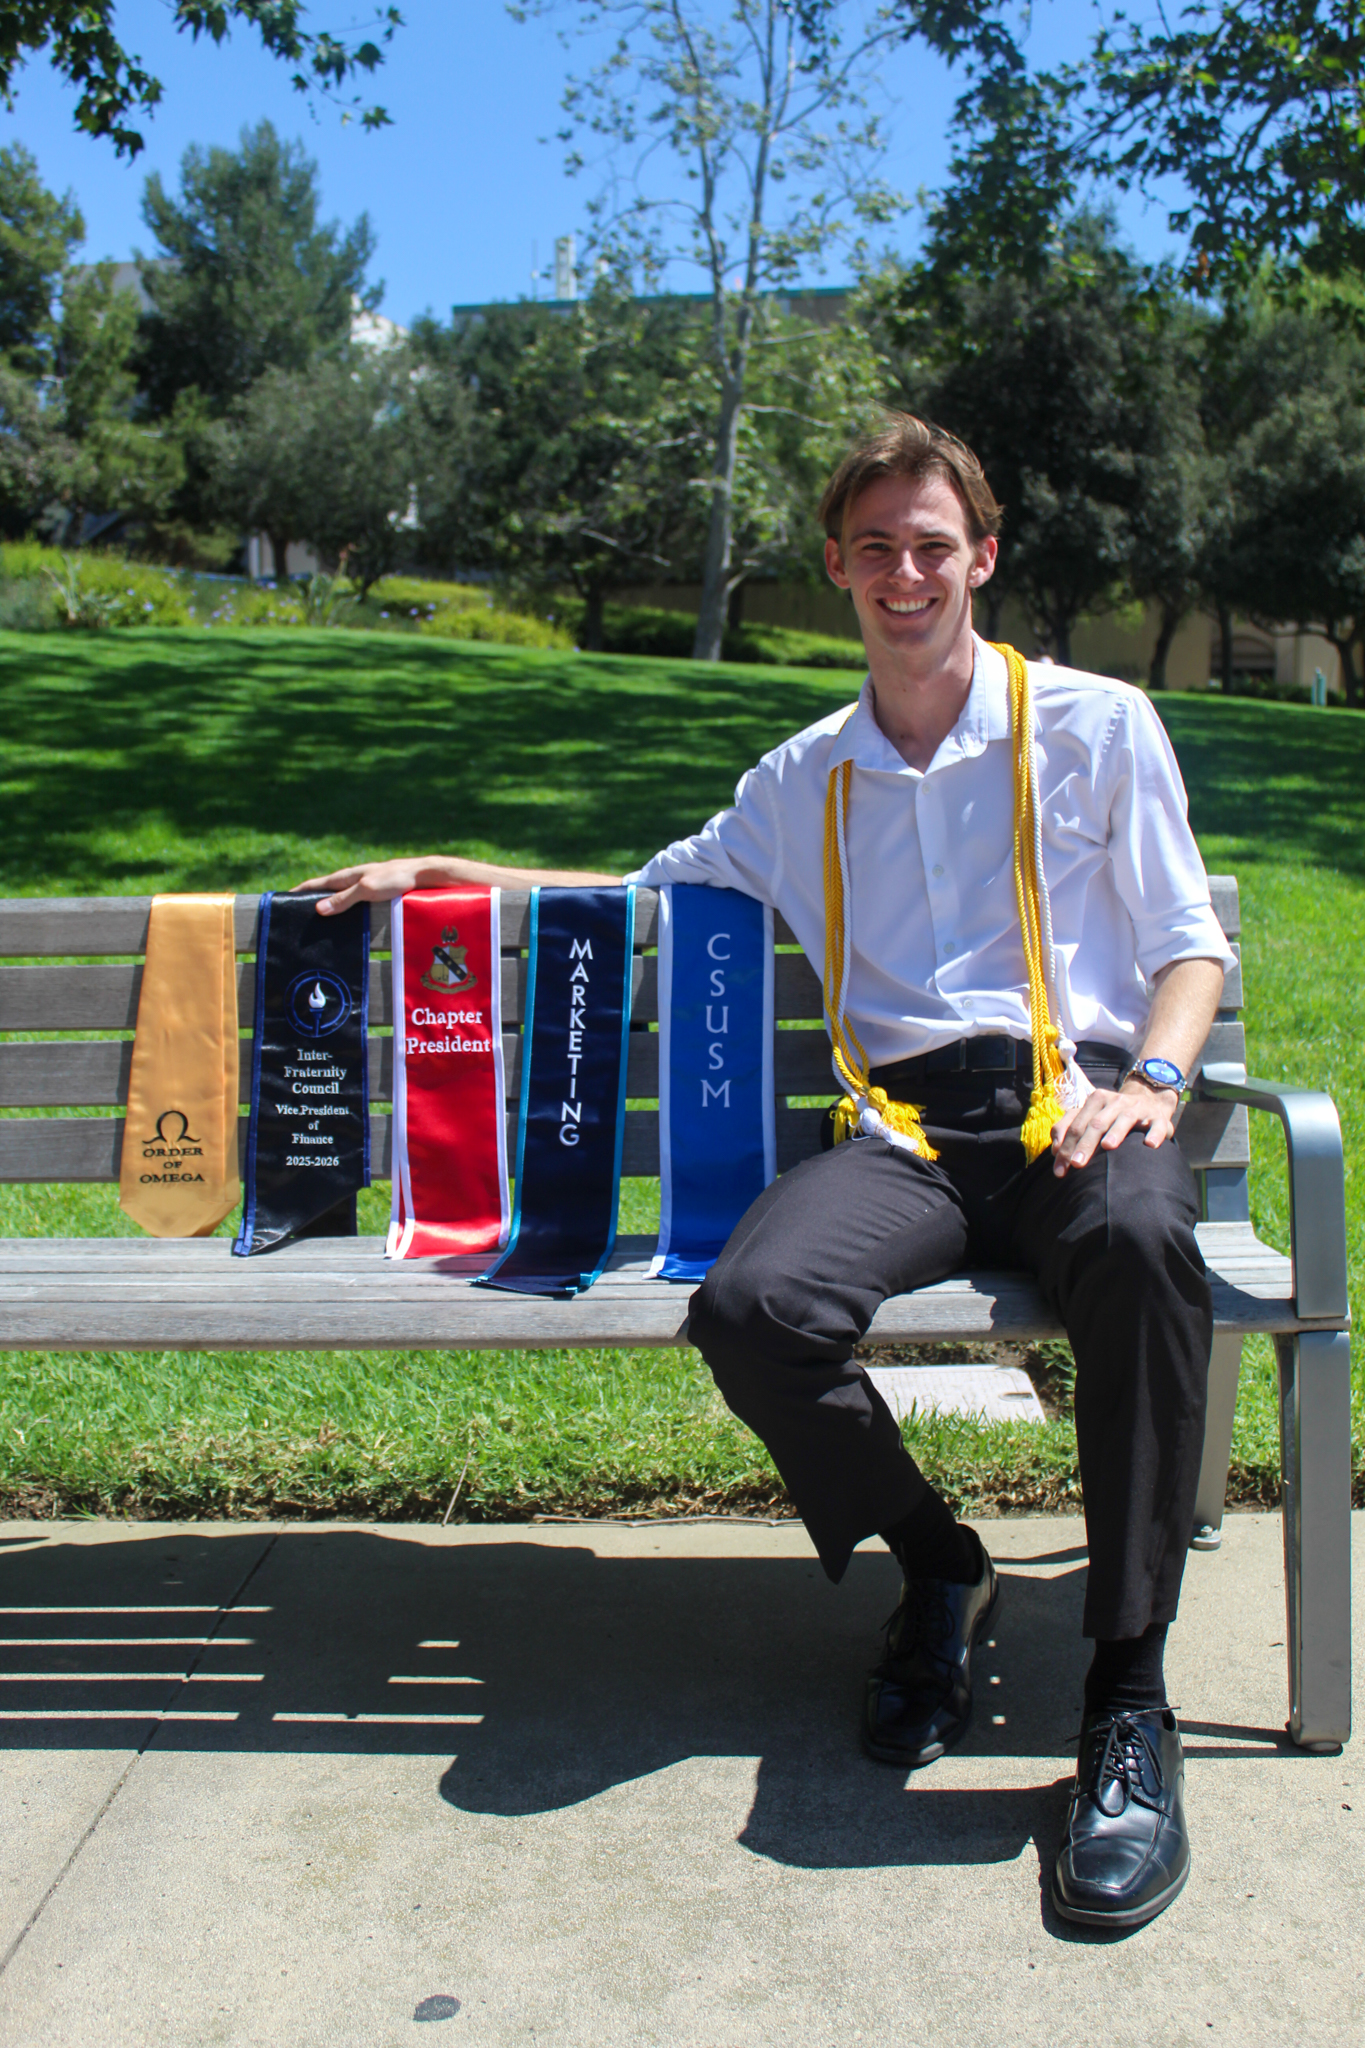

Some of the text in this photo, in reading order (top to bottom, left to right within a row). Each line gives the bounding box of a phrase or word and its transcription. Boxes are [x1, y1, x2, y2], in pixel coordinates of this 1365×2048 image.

[411, 1007, 483, 1030] Chapter
[701, 933, 732, 1108] CSUSM
[405, 1035, 491, 1055] President
[559, 938, 593, 1146] MARKETING
[297, 1049, 333, 1061] Inter-
[284, 1066, 347, 1080] Fraternity
[292, 1082, 340, 1094] Council
[300, 1105, 349, 1116] President
[308, 1120, 320, 1131] of
[291, 1133, 334, 1145] Finance
[143, 1148, 204, 1157] ORDER
[163, 1161, 182, 1169] OF
[286, 1156, 340, 1167] 2025-2026
[140, 1173, 205, 1184] OMEGA
